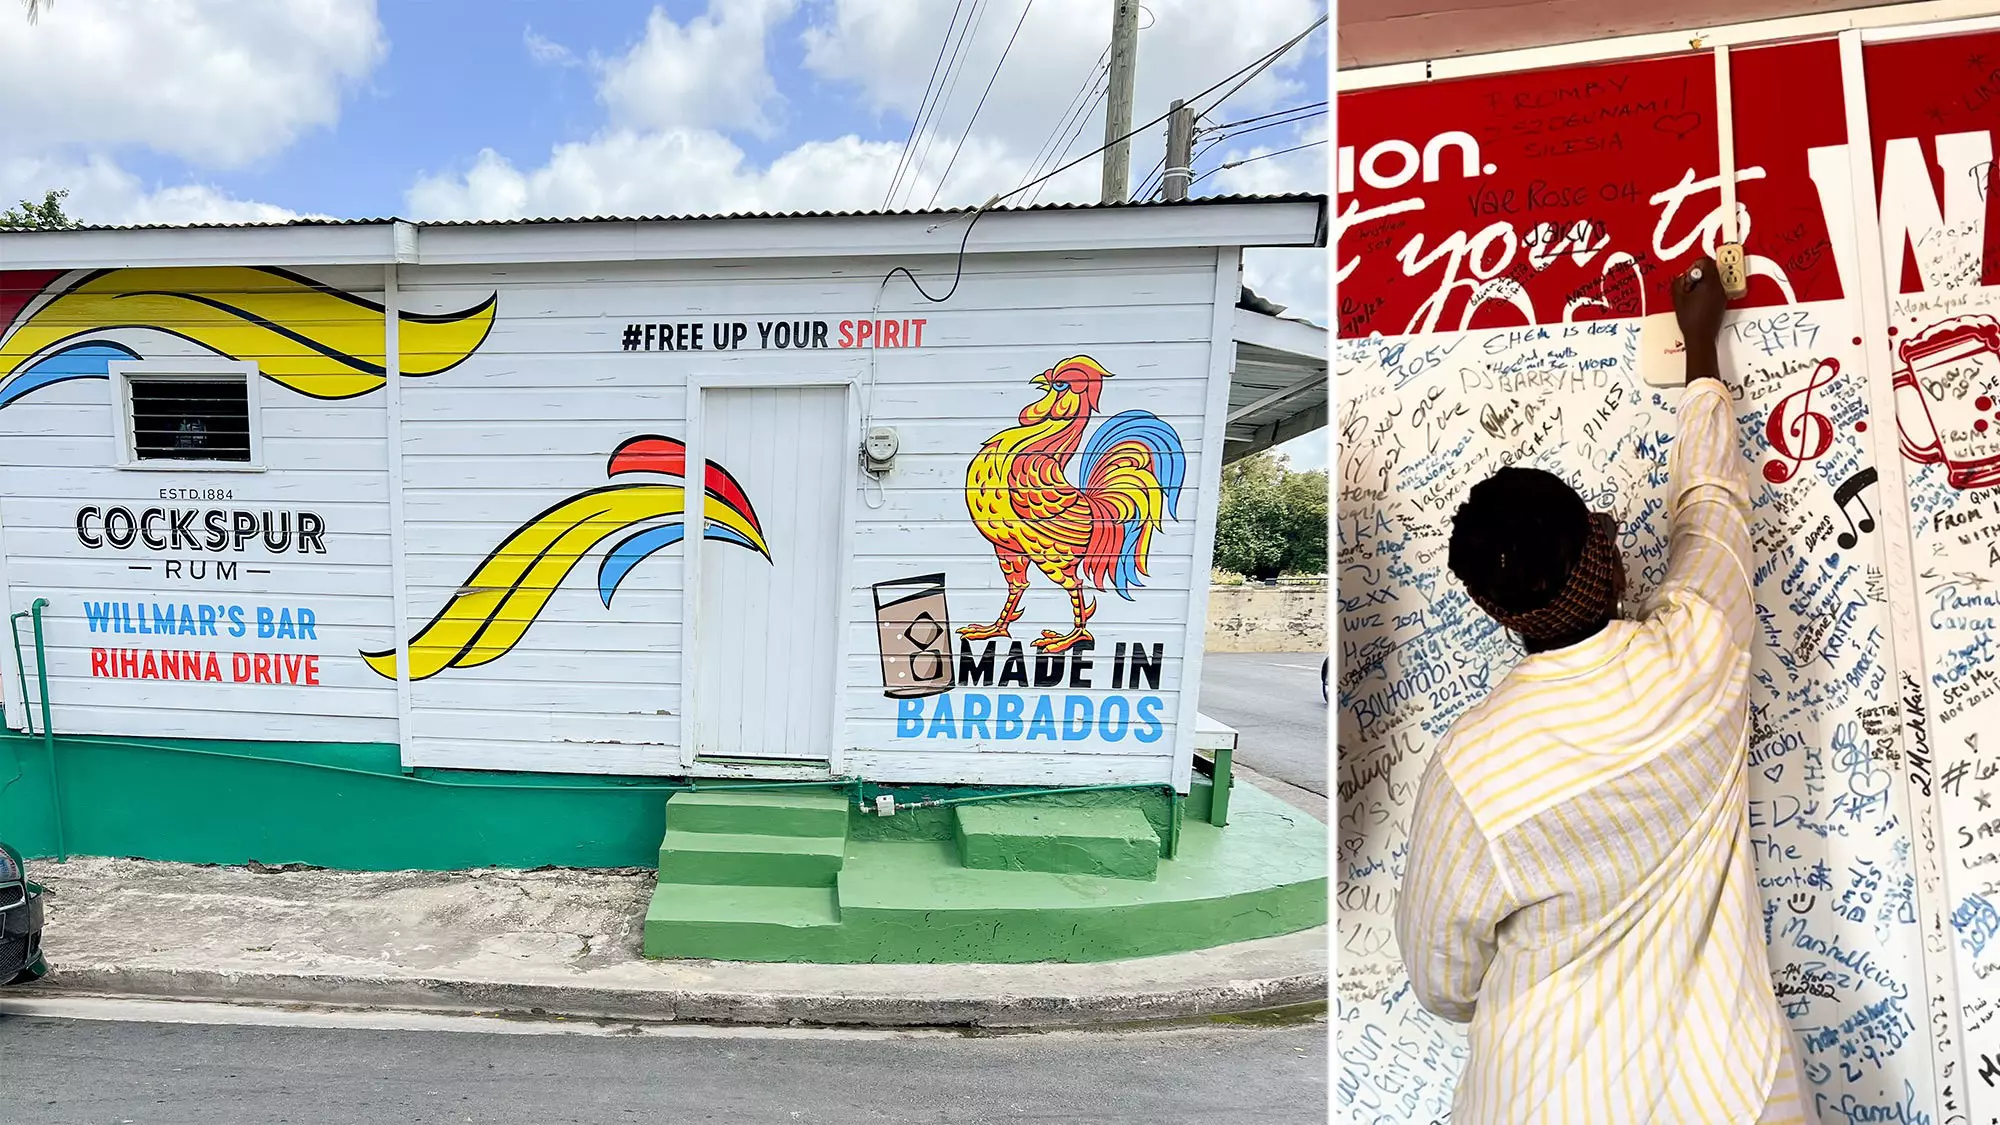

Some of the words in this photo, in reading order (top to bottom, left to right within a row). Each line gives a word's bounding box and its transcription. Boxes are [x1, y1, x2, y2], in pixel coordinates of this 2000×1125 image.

[622, 323, 703, 352] #FREE
[713, 322, 747, 351] UP
[756, 320, 829, 350] YOUR
[837, 318, 927, 349] SPIRIT
[75, 505, 328, 555] COCKSPUR
[1933, 508, 1983, 533] FROM
[164, 561, 238, 582] RUM
[83, 600, 246, 638] WILLMAR'S
[256, 606, 317, 641] BAR
[91, 647, 222, 683] RIHANNA
[232, 651, 320, 687] DRIVE
[955, 638, 1094, 689] MADE
[1111, 642, 1164, 690] IN
[898, 694, 1165, 743] BARBADOS
